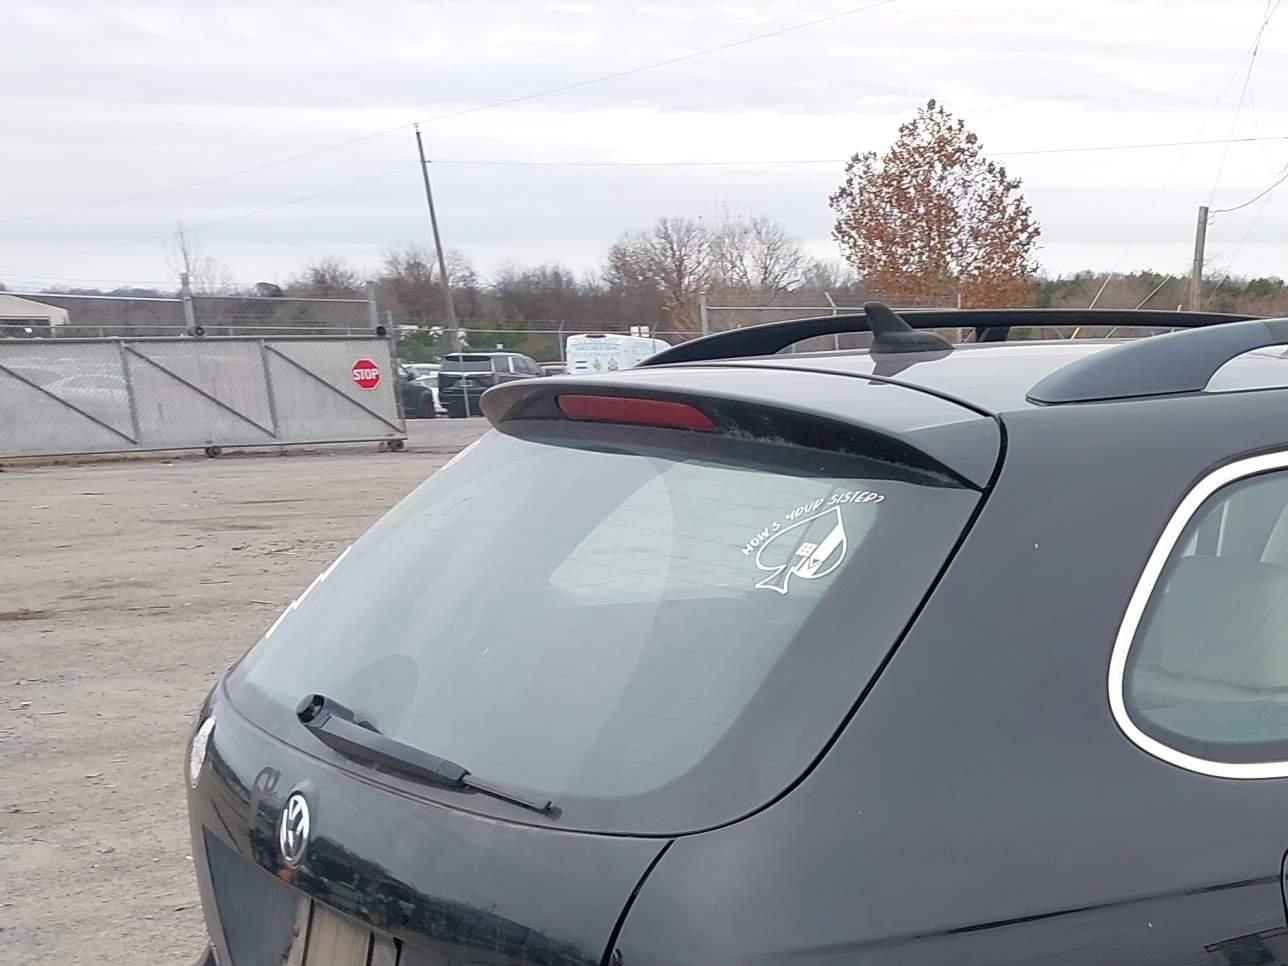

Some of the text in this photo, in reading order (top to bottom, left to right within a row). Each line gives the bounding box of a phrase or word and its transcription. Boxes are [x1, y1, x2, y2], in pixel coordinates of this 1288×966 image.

[353, 368, 379, 381] STOP
[742, 491, 885, 555] HOWS YOUR SISTER?
